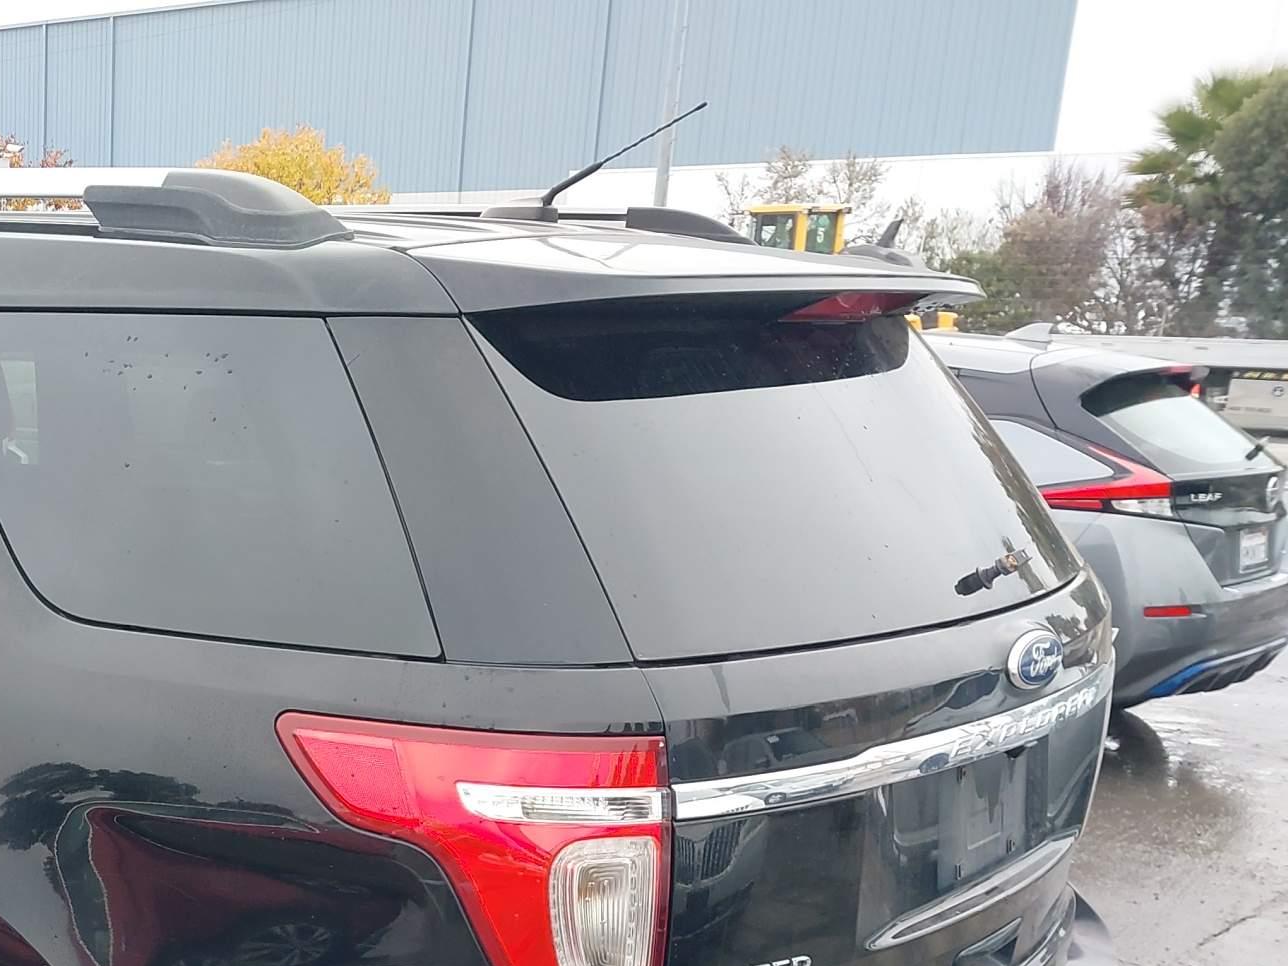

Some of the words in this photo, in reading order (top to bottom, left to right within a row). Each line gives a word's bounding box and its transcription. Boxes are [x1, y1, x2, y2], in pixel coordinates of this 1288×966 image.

[816, 227, 825, 243] 5
[1191, 492, 1223, 502] LEAF
[1030, 641, 1062, 677] Ford
[948, 686, 1098, 761] EXPLORER
